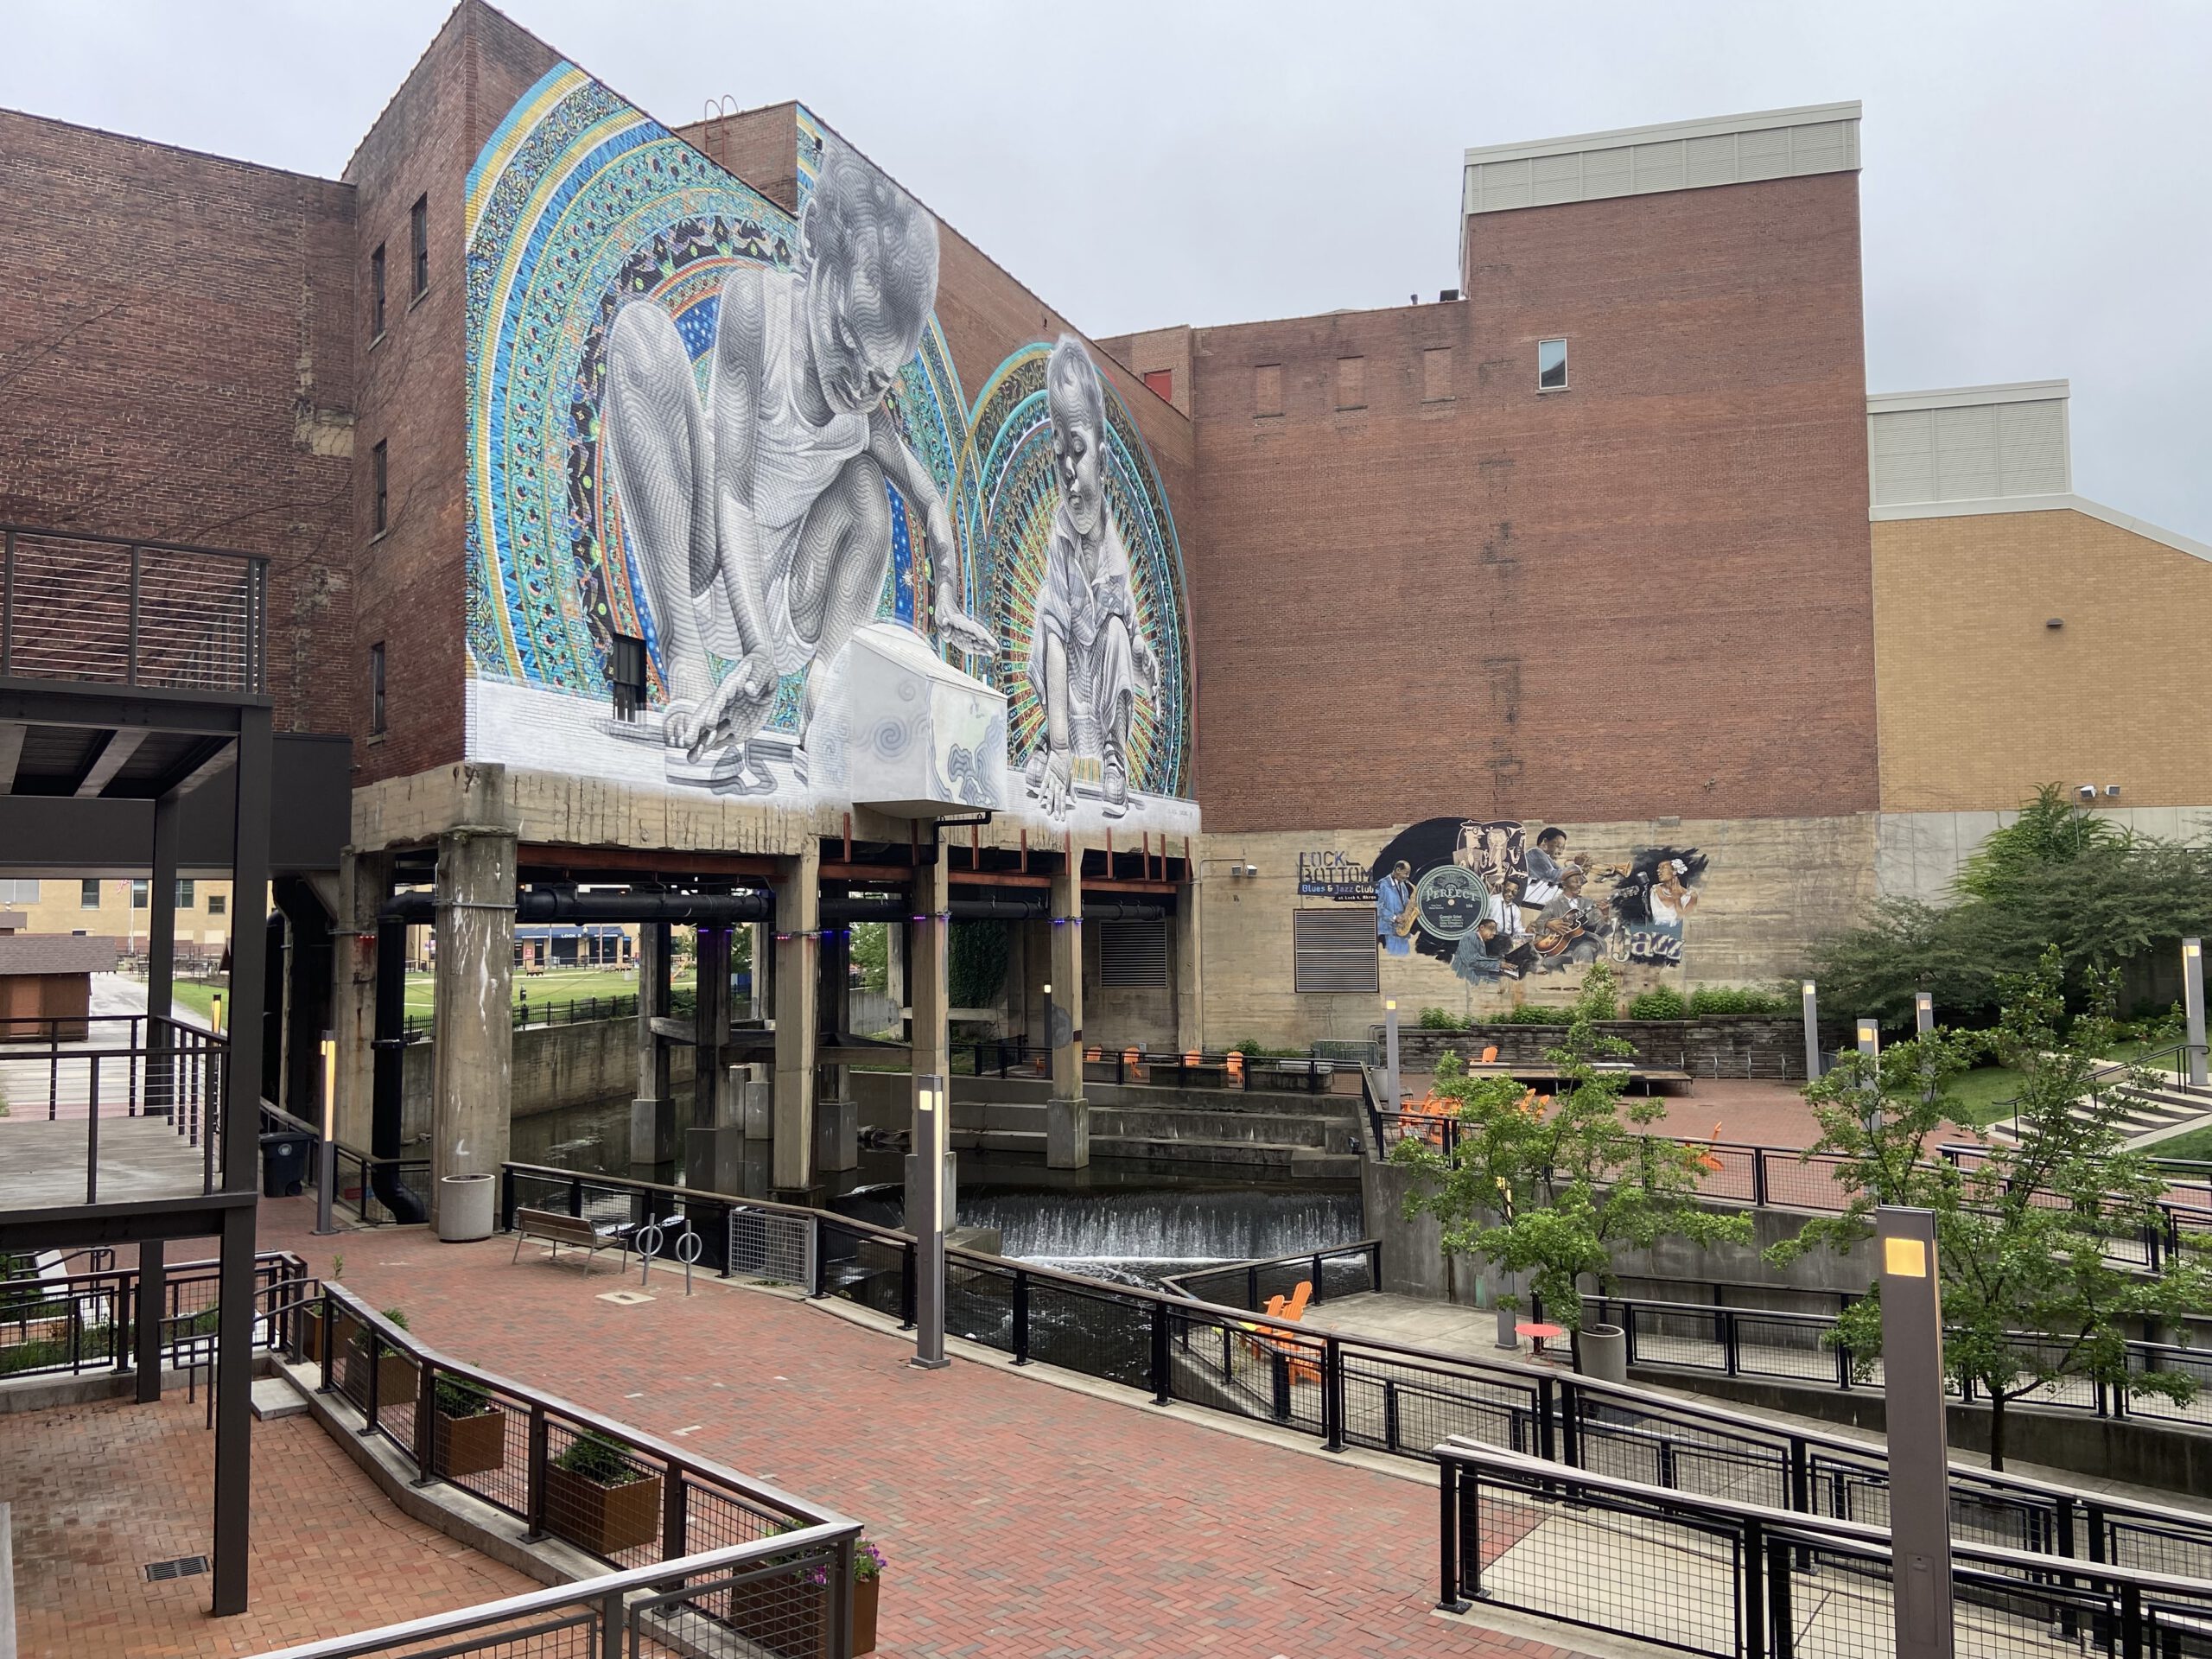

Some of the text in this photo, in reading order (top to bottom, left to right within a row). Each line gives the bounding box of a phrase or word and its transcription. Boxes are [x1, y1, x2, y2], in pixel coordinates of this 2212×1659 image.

[1299, 851, 1359, 868] LOCK
[1299, 867, 1373, 883] BOTTOM
[1301, 884, 1325, 893] Blues
[1355, 885, 1374, 893] Club
